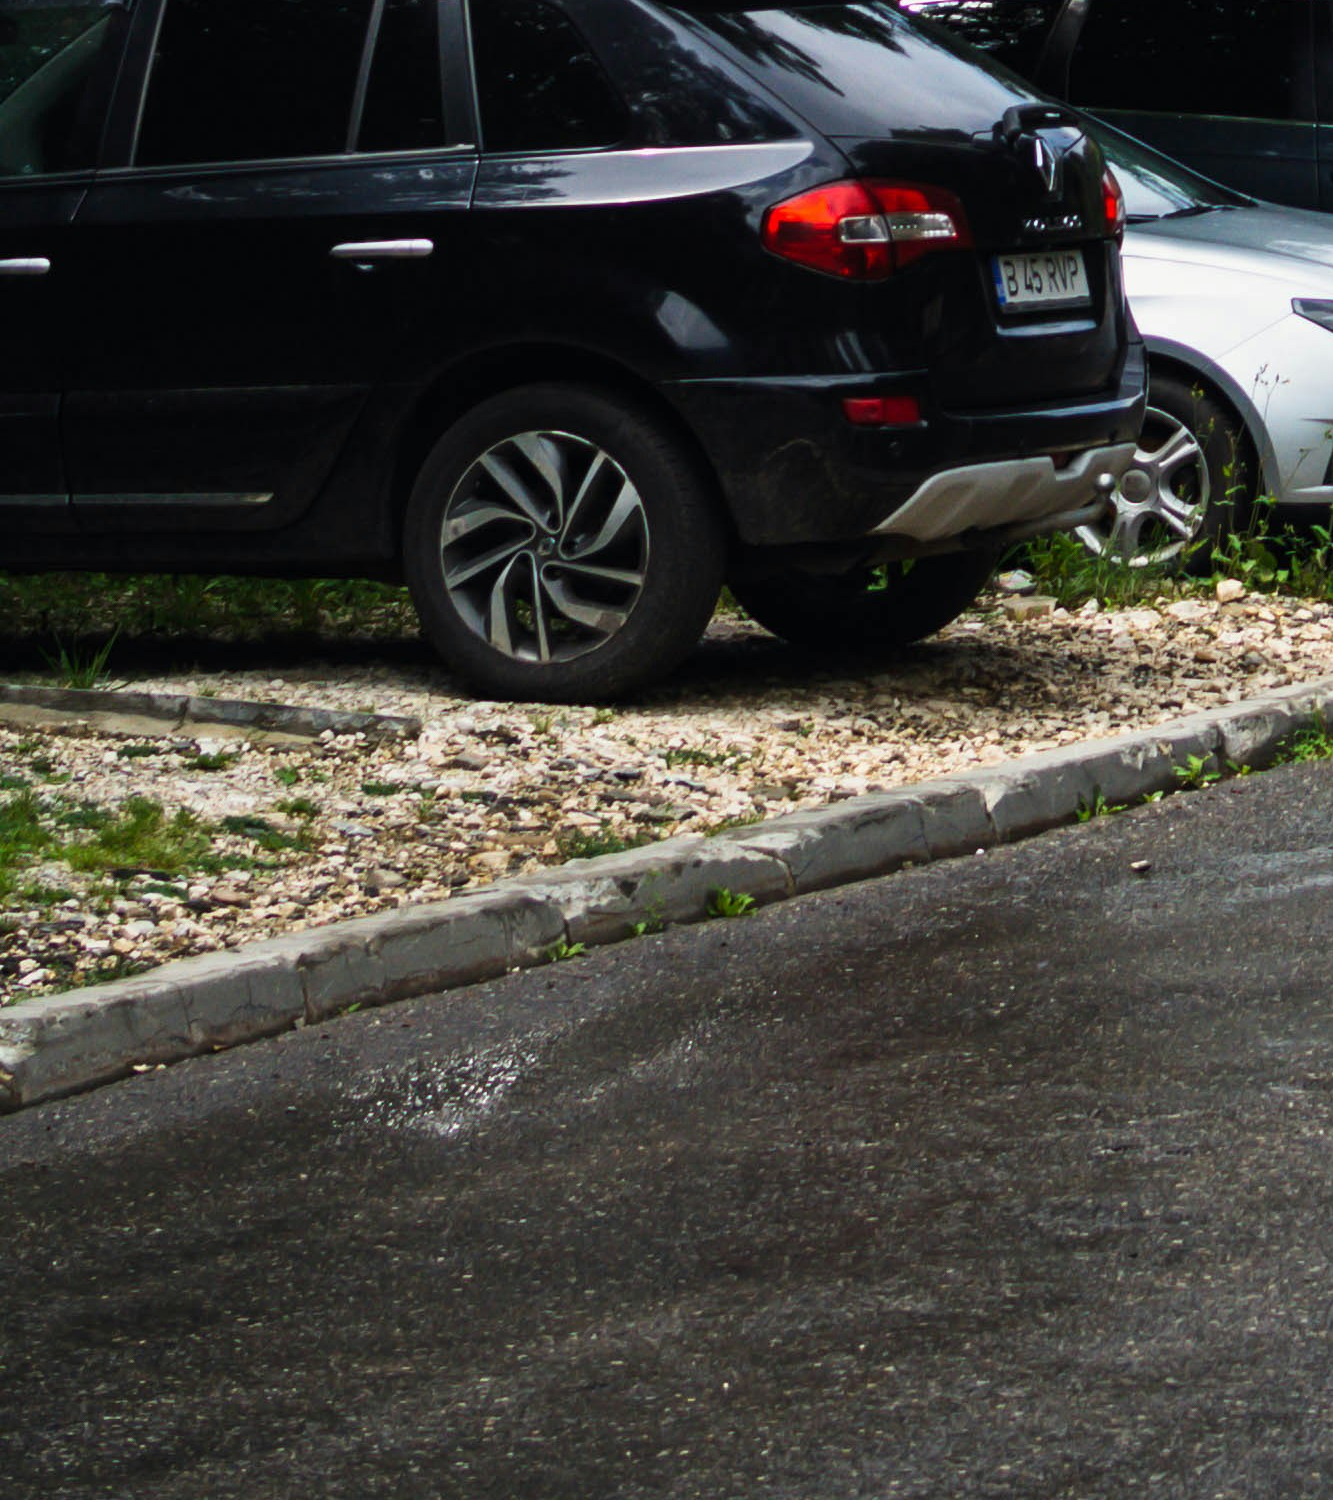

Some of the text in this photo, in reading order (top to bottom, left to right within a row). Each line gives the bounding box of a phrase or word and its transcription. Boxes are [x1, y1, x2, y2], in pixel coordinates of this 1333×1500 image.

[1002, 255, 1079, 297] B 45 RVP
